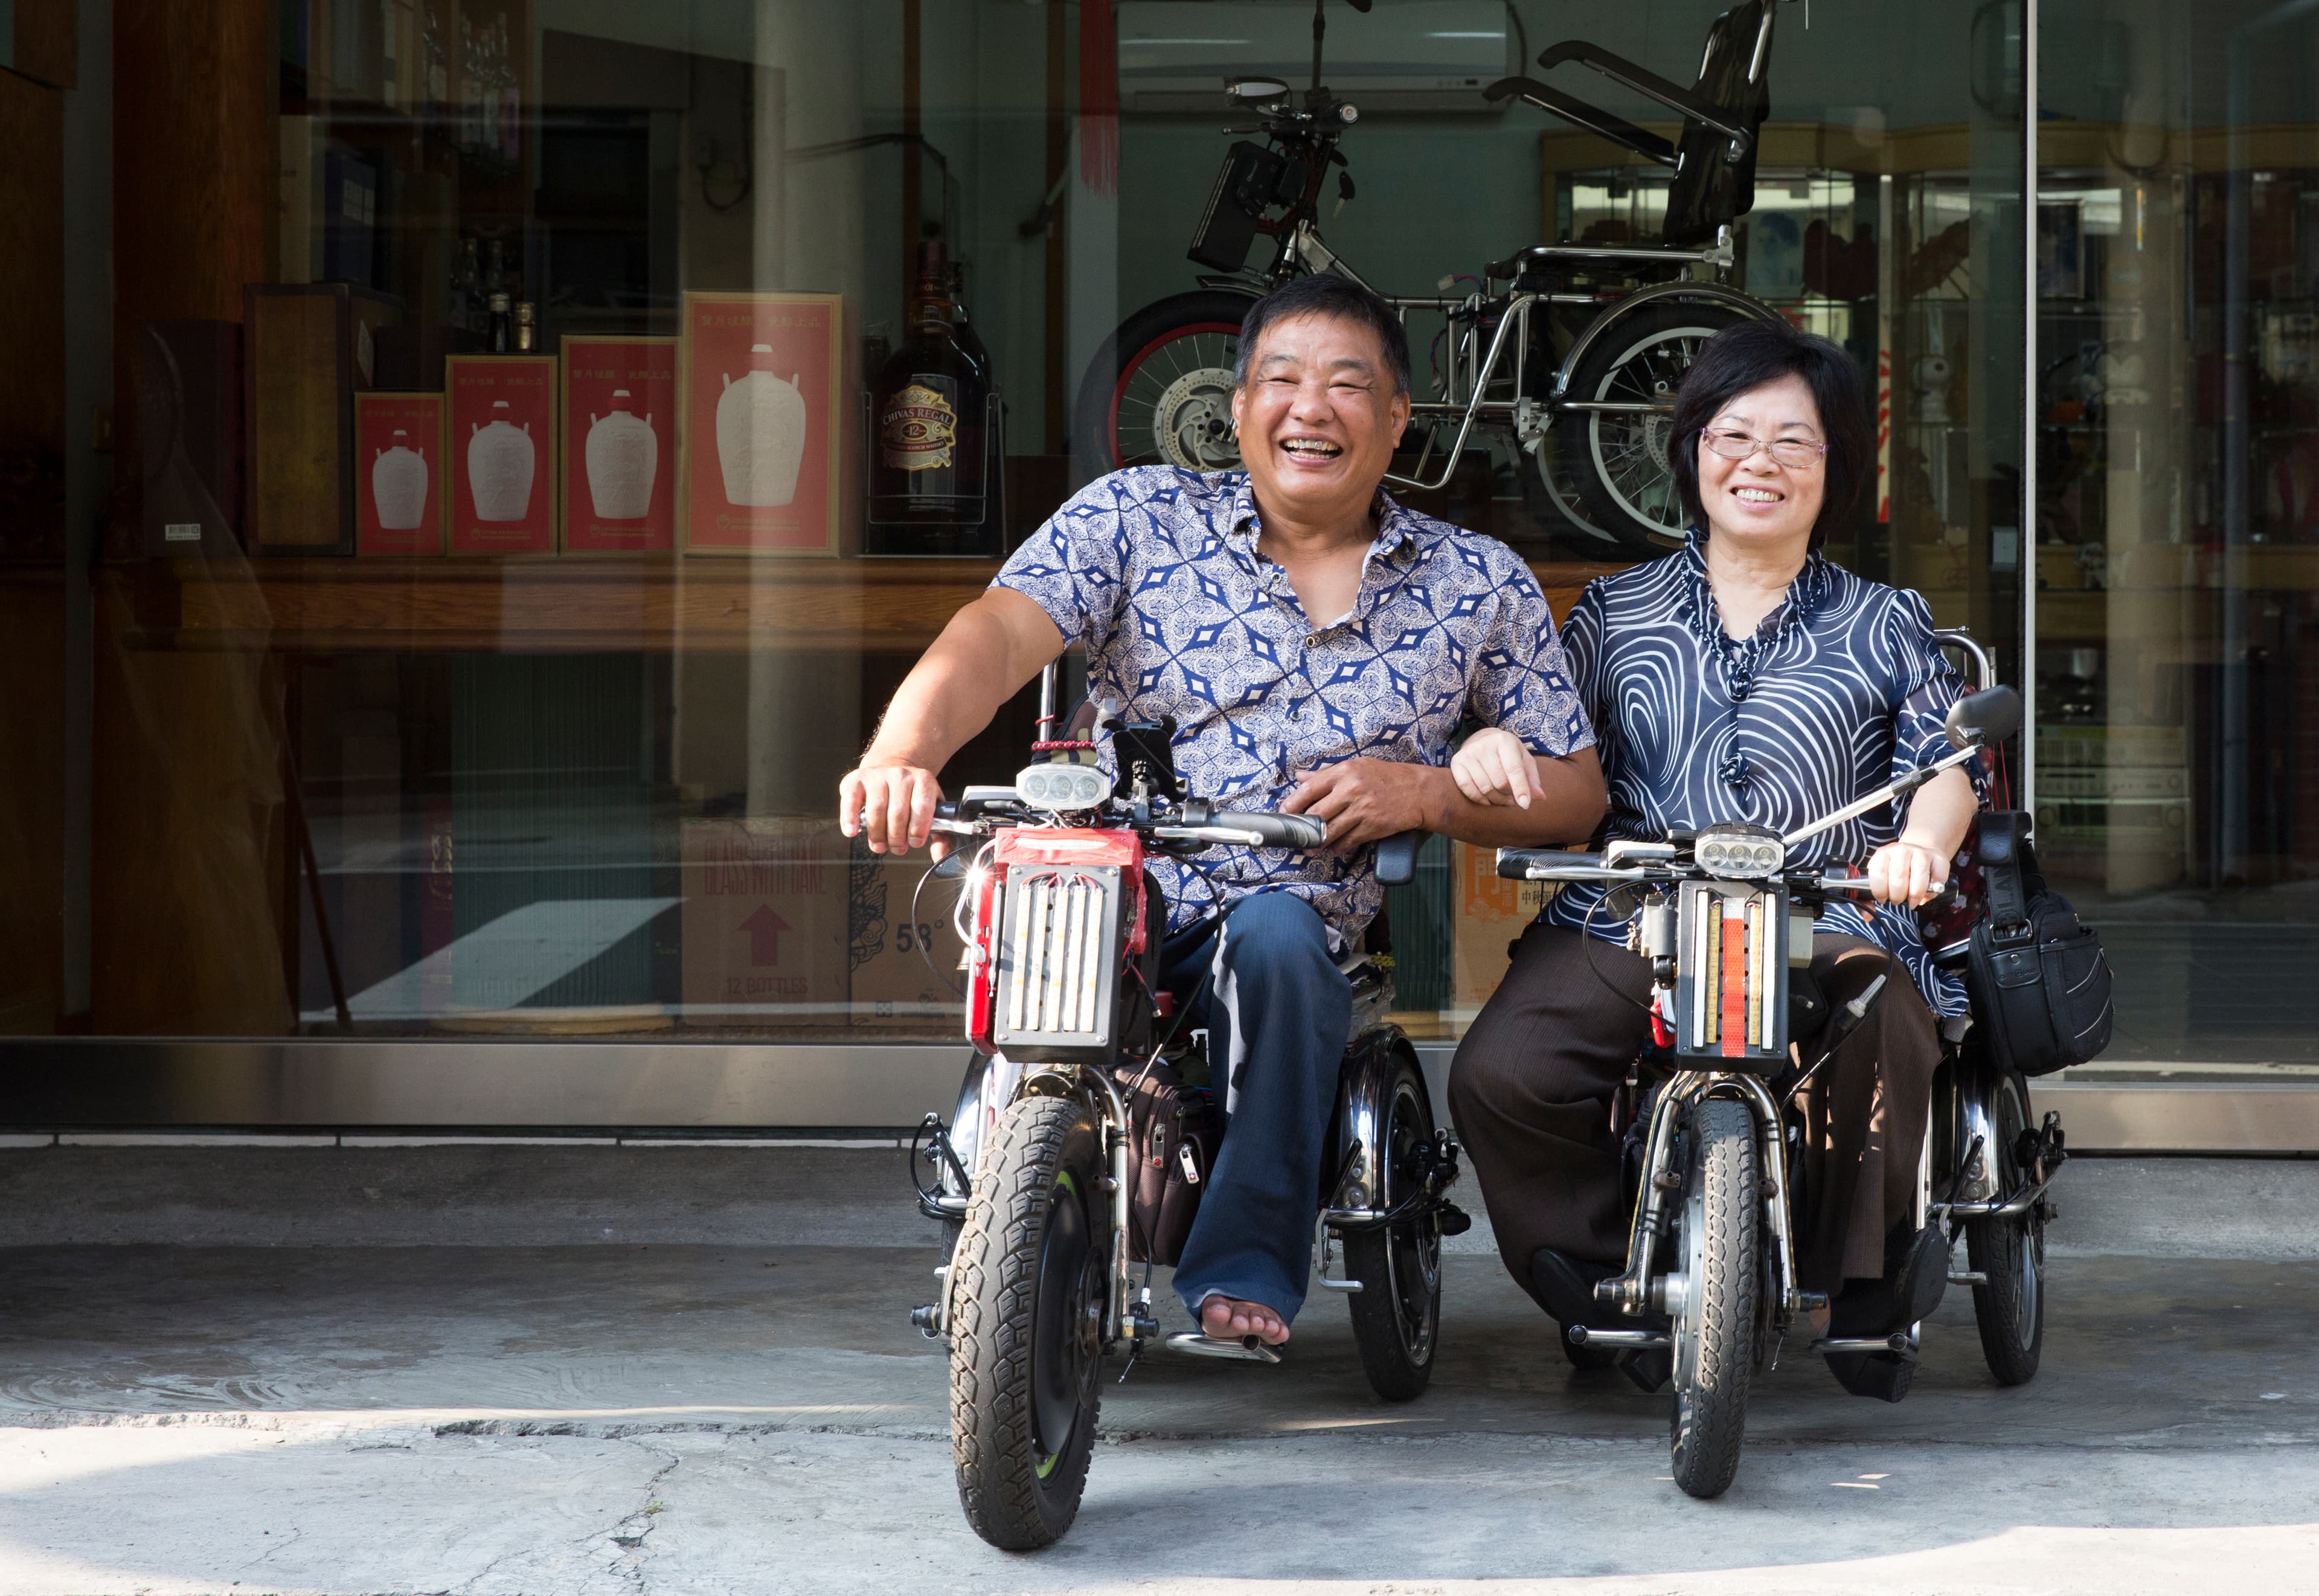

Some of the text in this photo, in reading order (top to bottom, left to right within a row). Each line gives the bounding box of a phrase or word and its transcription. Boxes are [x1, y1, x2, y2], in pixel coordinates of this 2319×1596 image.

[883, 408, 951, 425] CHIVAS REGAL
[908, 425, 920, 435] 12
[726, 976, 809, 995] 12 BOTTLES
